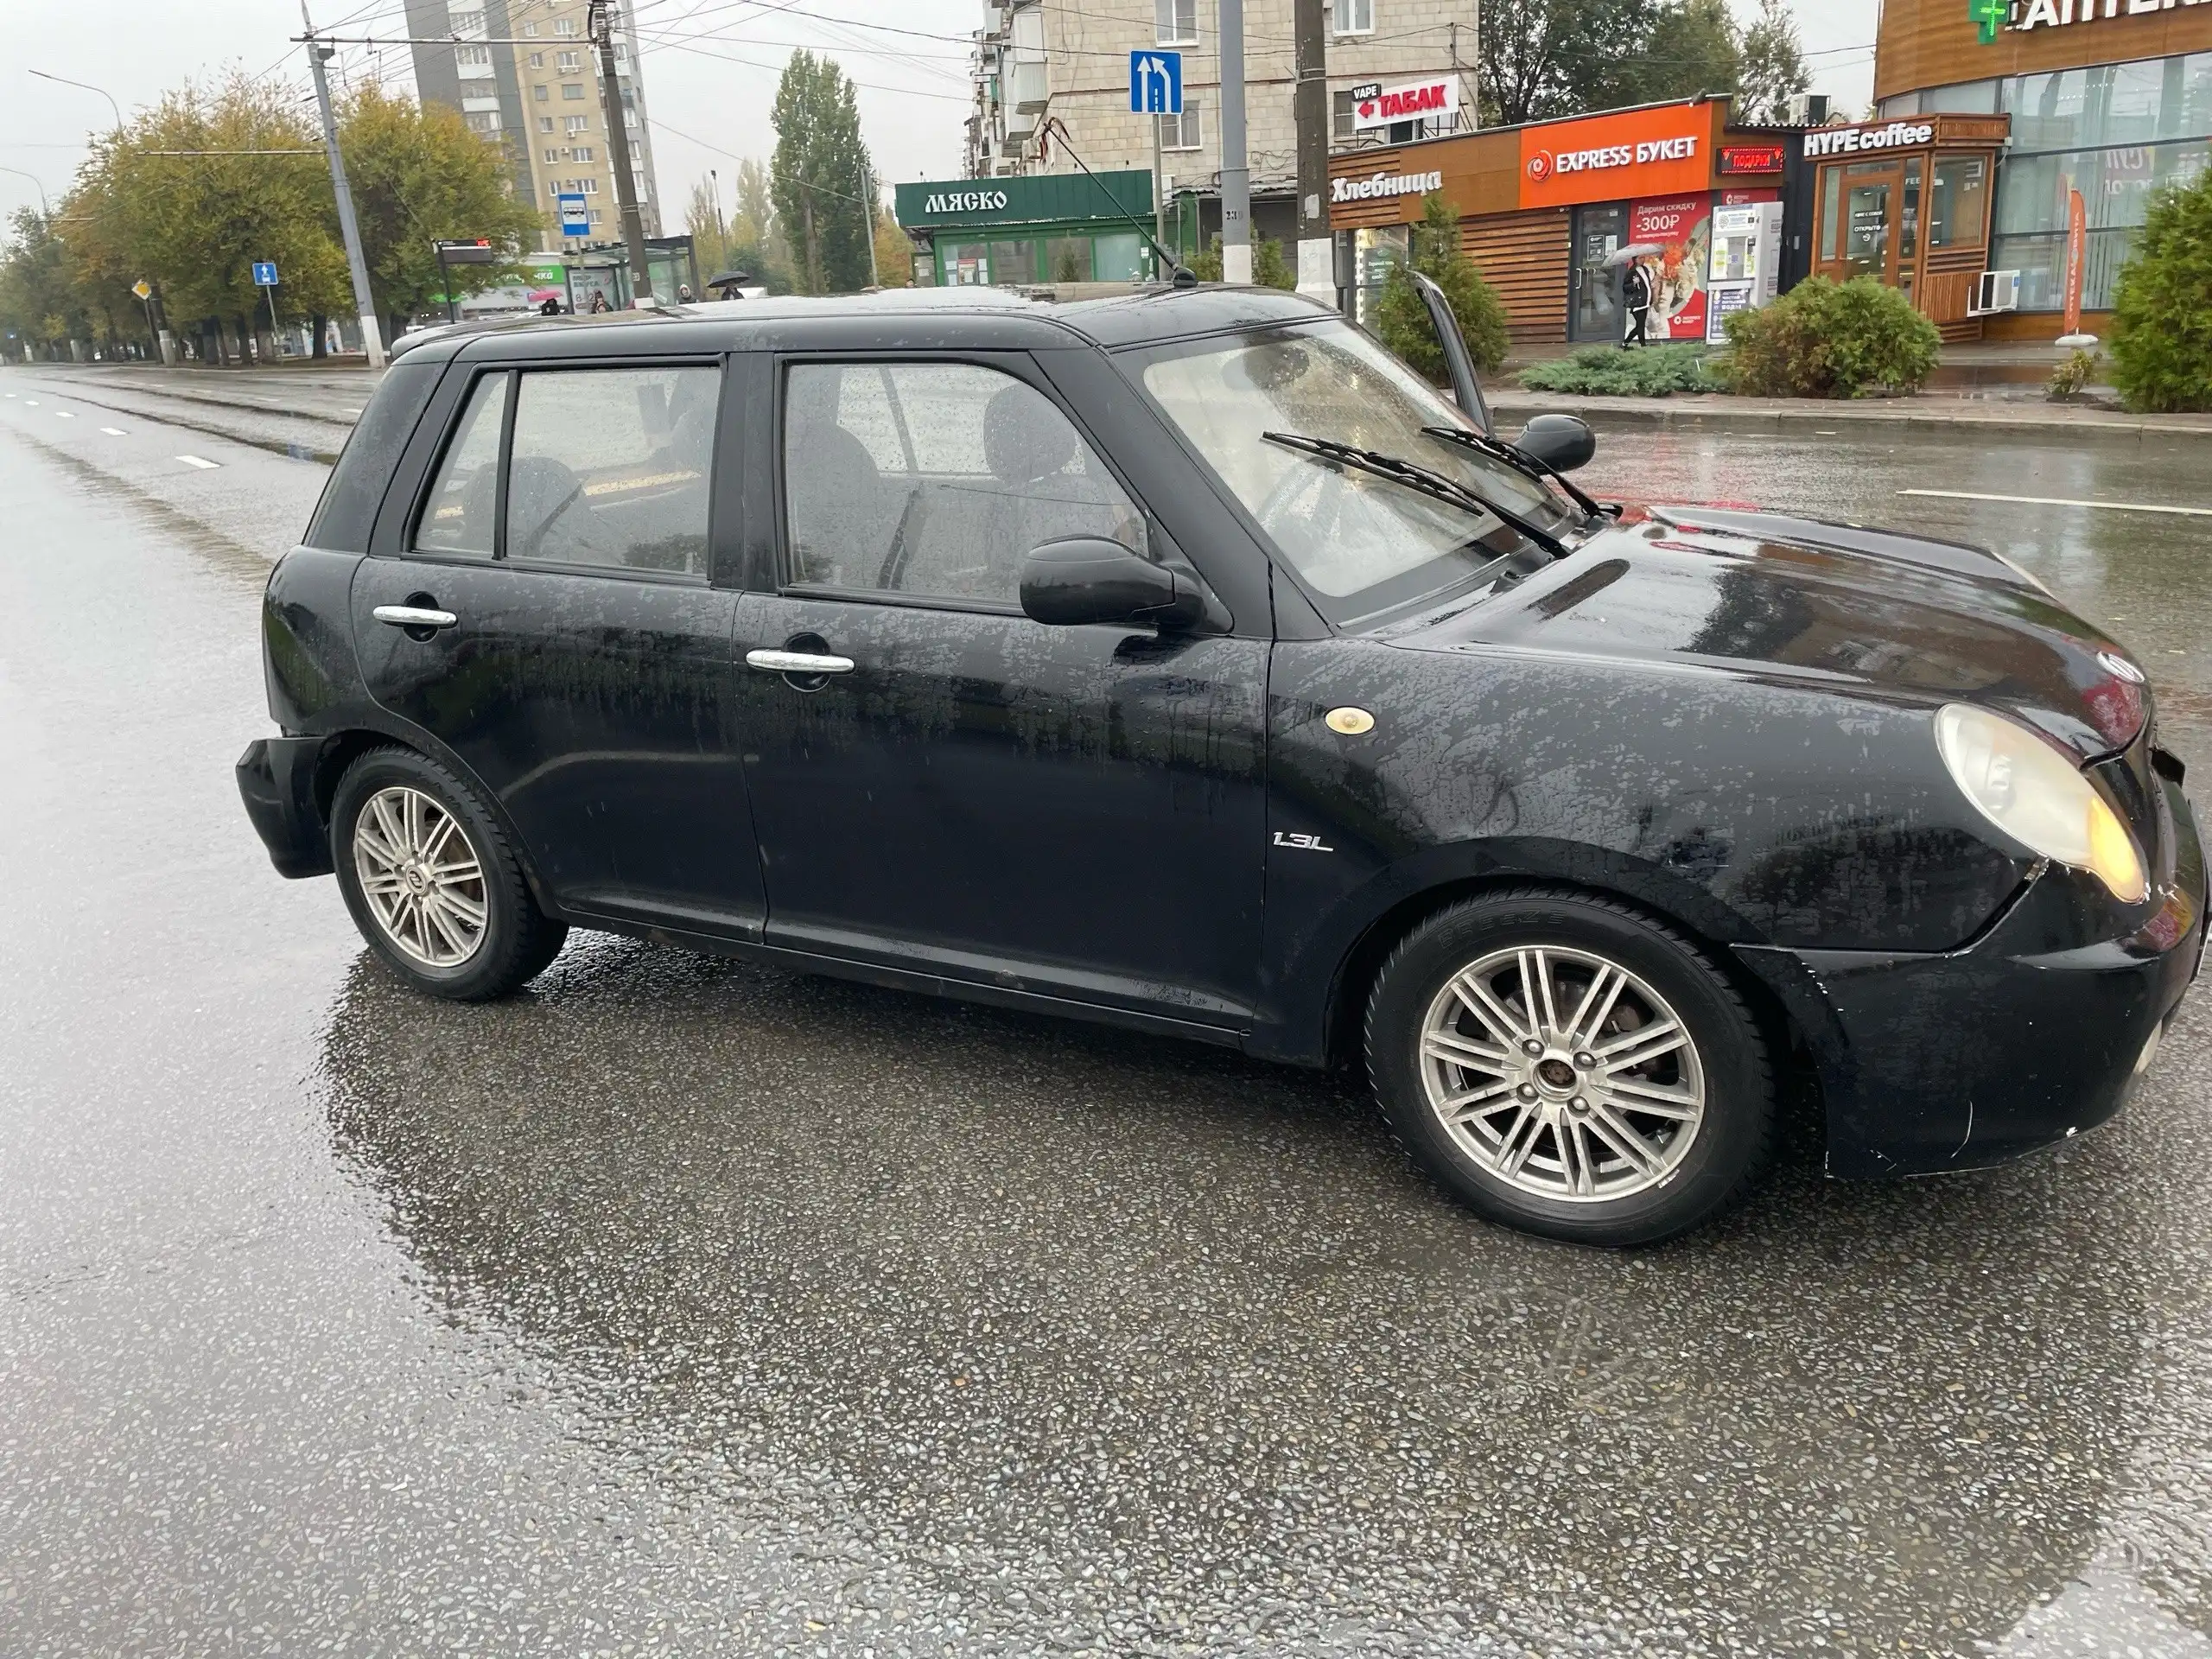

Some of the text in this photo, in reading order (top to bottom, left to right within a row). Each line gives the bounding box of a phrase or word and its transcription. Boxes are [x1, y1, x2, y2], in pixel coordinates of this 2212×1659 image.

[1353, 85, 1377, 99] VAPE
[1378, 85, 1447, 118] ТАБАК
[1556, 136, 1699, 174] EXPRESS БУКЕТ
[925, 190, 1007, 213] МЯСКО
[1332, 171, 1443, 202] Хлебница
